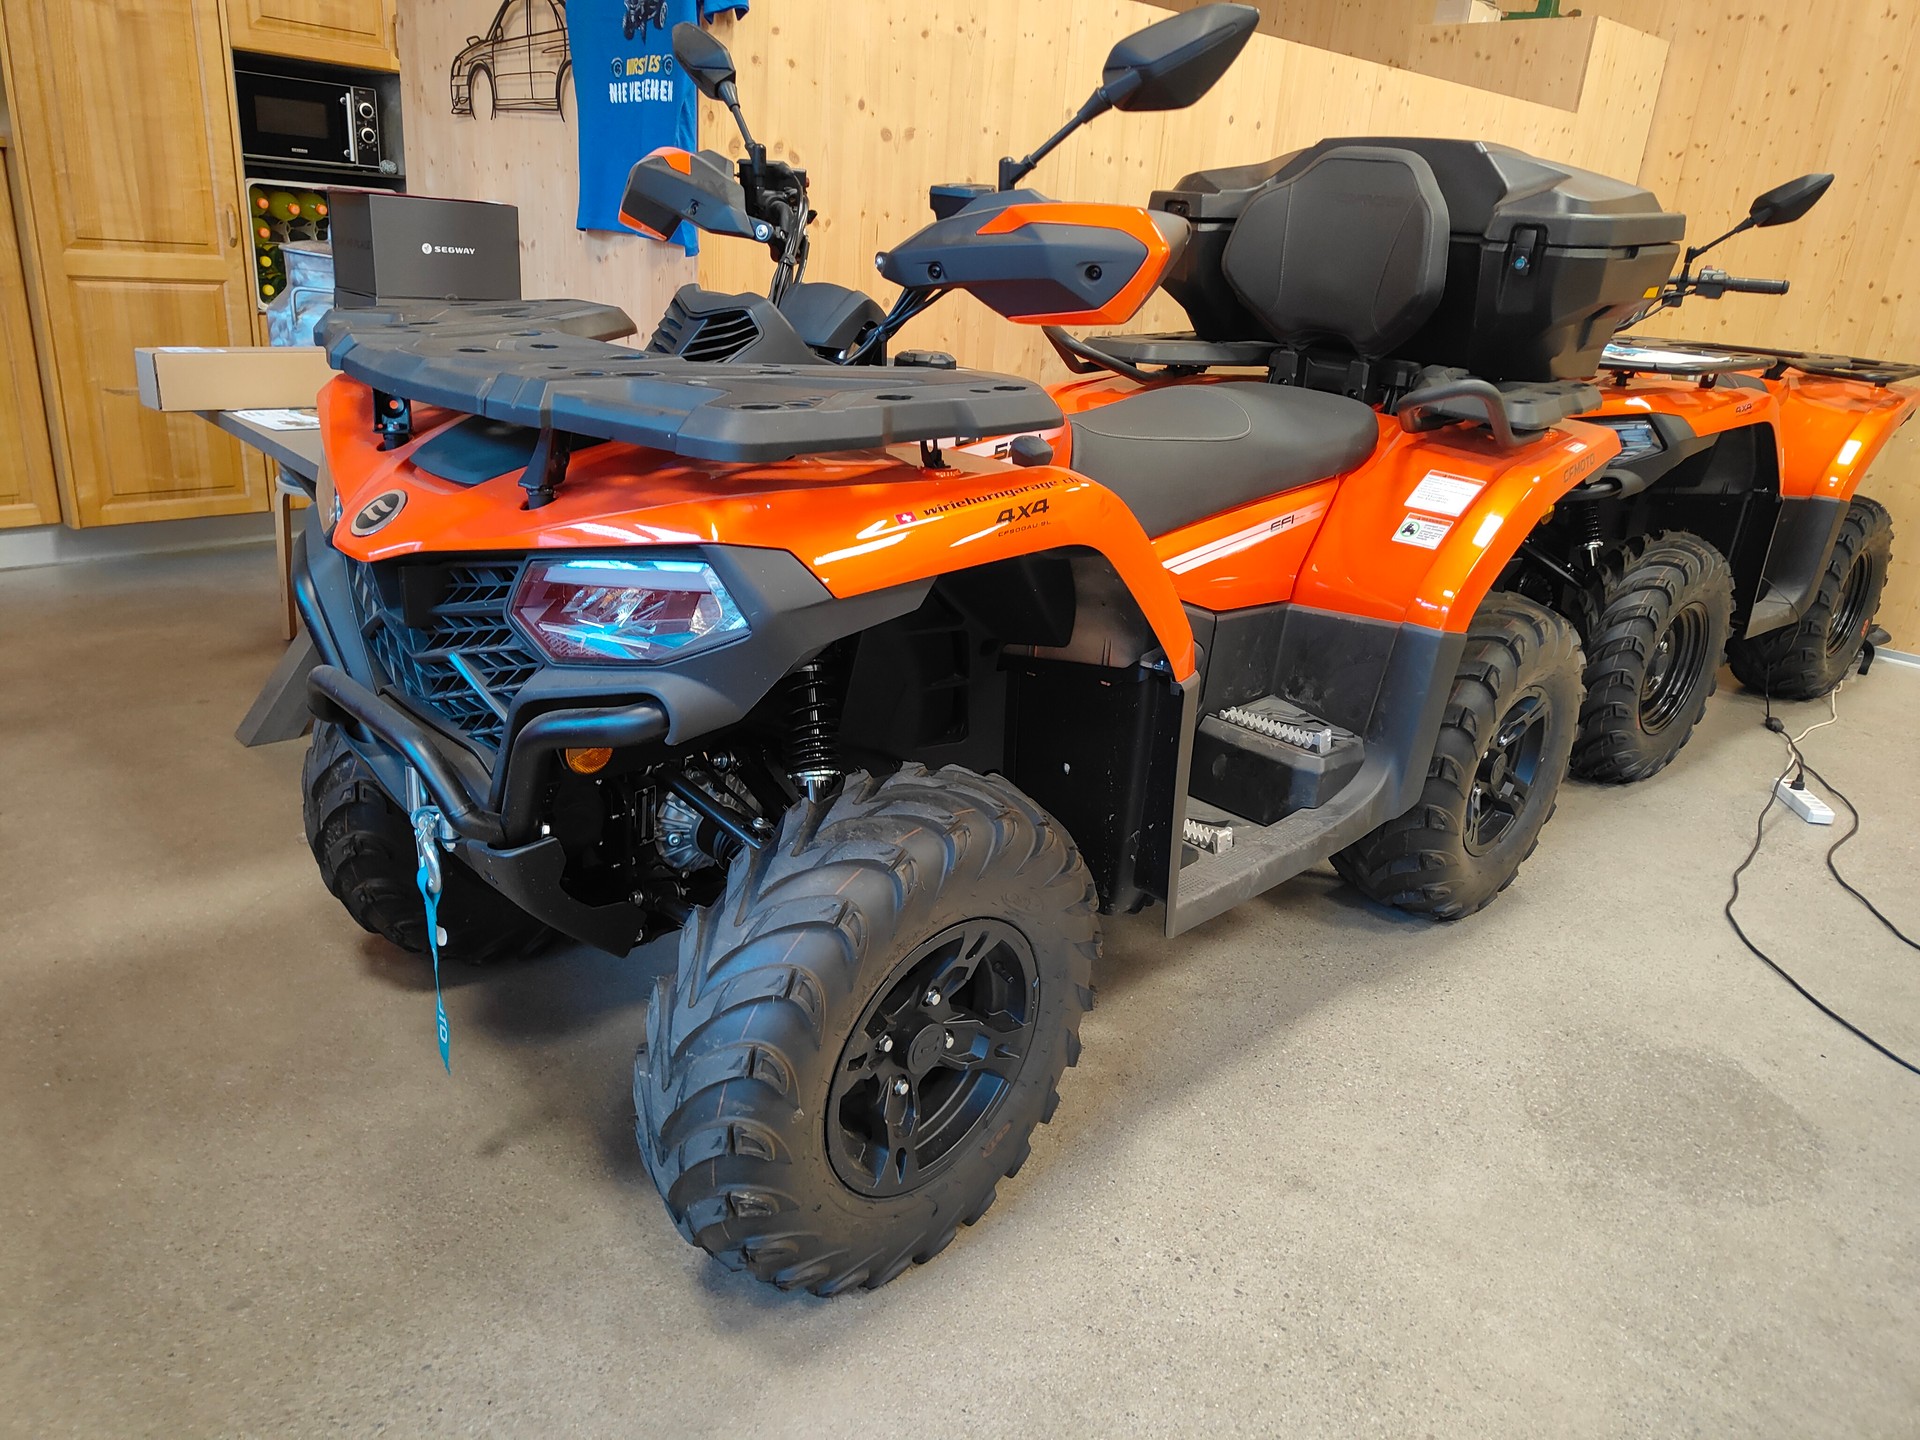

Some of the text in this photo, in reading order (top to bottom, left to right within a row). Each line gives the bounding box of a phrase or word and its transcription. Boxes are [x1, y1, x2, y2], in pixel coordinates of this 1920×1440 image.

[609, 82, 628, 104] NIE
[434, 245, 476, 255] SEGWAY
[1563, 452, 1595, 483] CFMOTO
[1270, 514, 1295, 532] EFI
